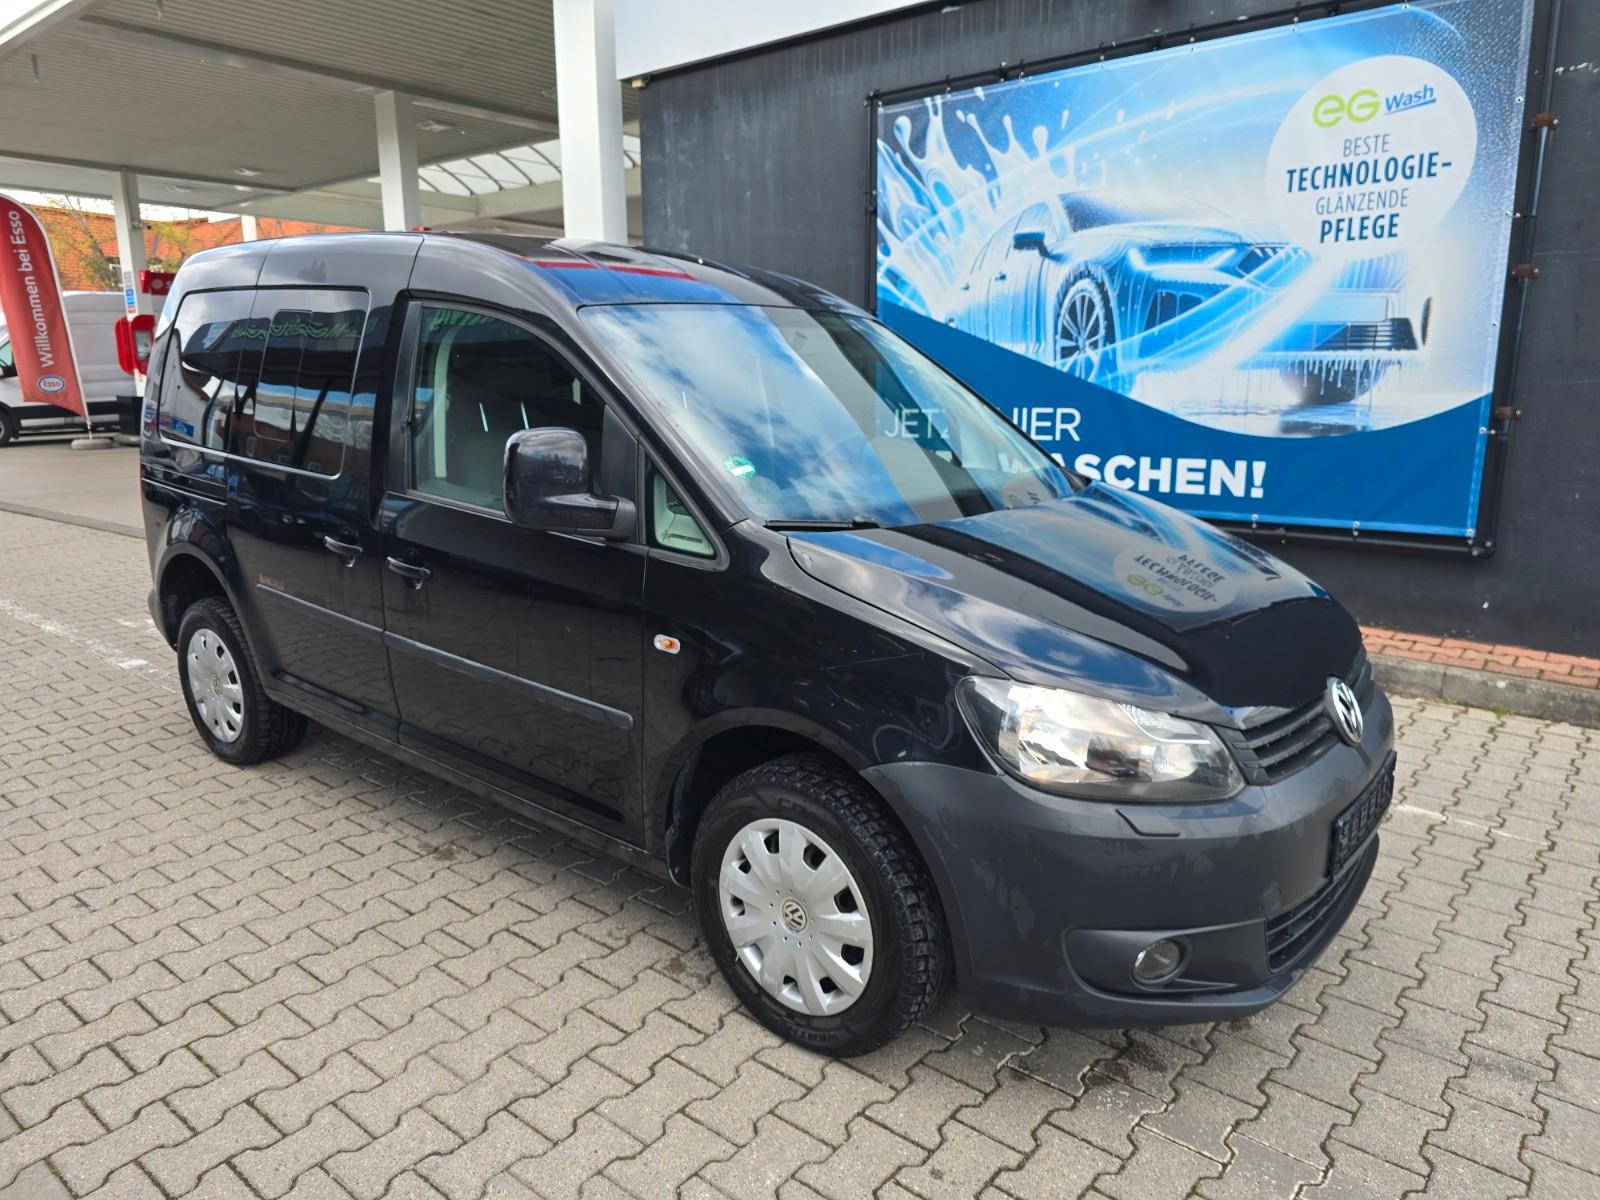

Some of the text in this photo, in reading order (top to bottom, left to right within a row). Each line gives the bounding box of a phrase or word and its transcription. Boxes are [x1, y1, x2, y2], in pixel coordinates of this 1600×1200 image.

[1385, 84, 1436, 114] Wash
[1343, 133, 1390, 158] BESTE
[1287, 152, 1452, 193] TECHNOLOGIE-
[1315, 187, 1409, 215] GLÄNZENDE
[1319, 212, 1399, 243] PFLEGE
[8, 210, 55, 369] Willkommen bei Esso
